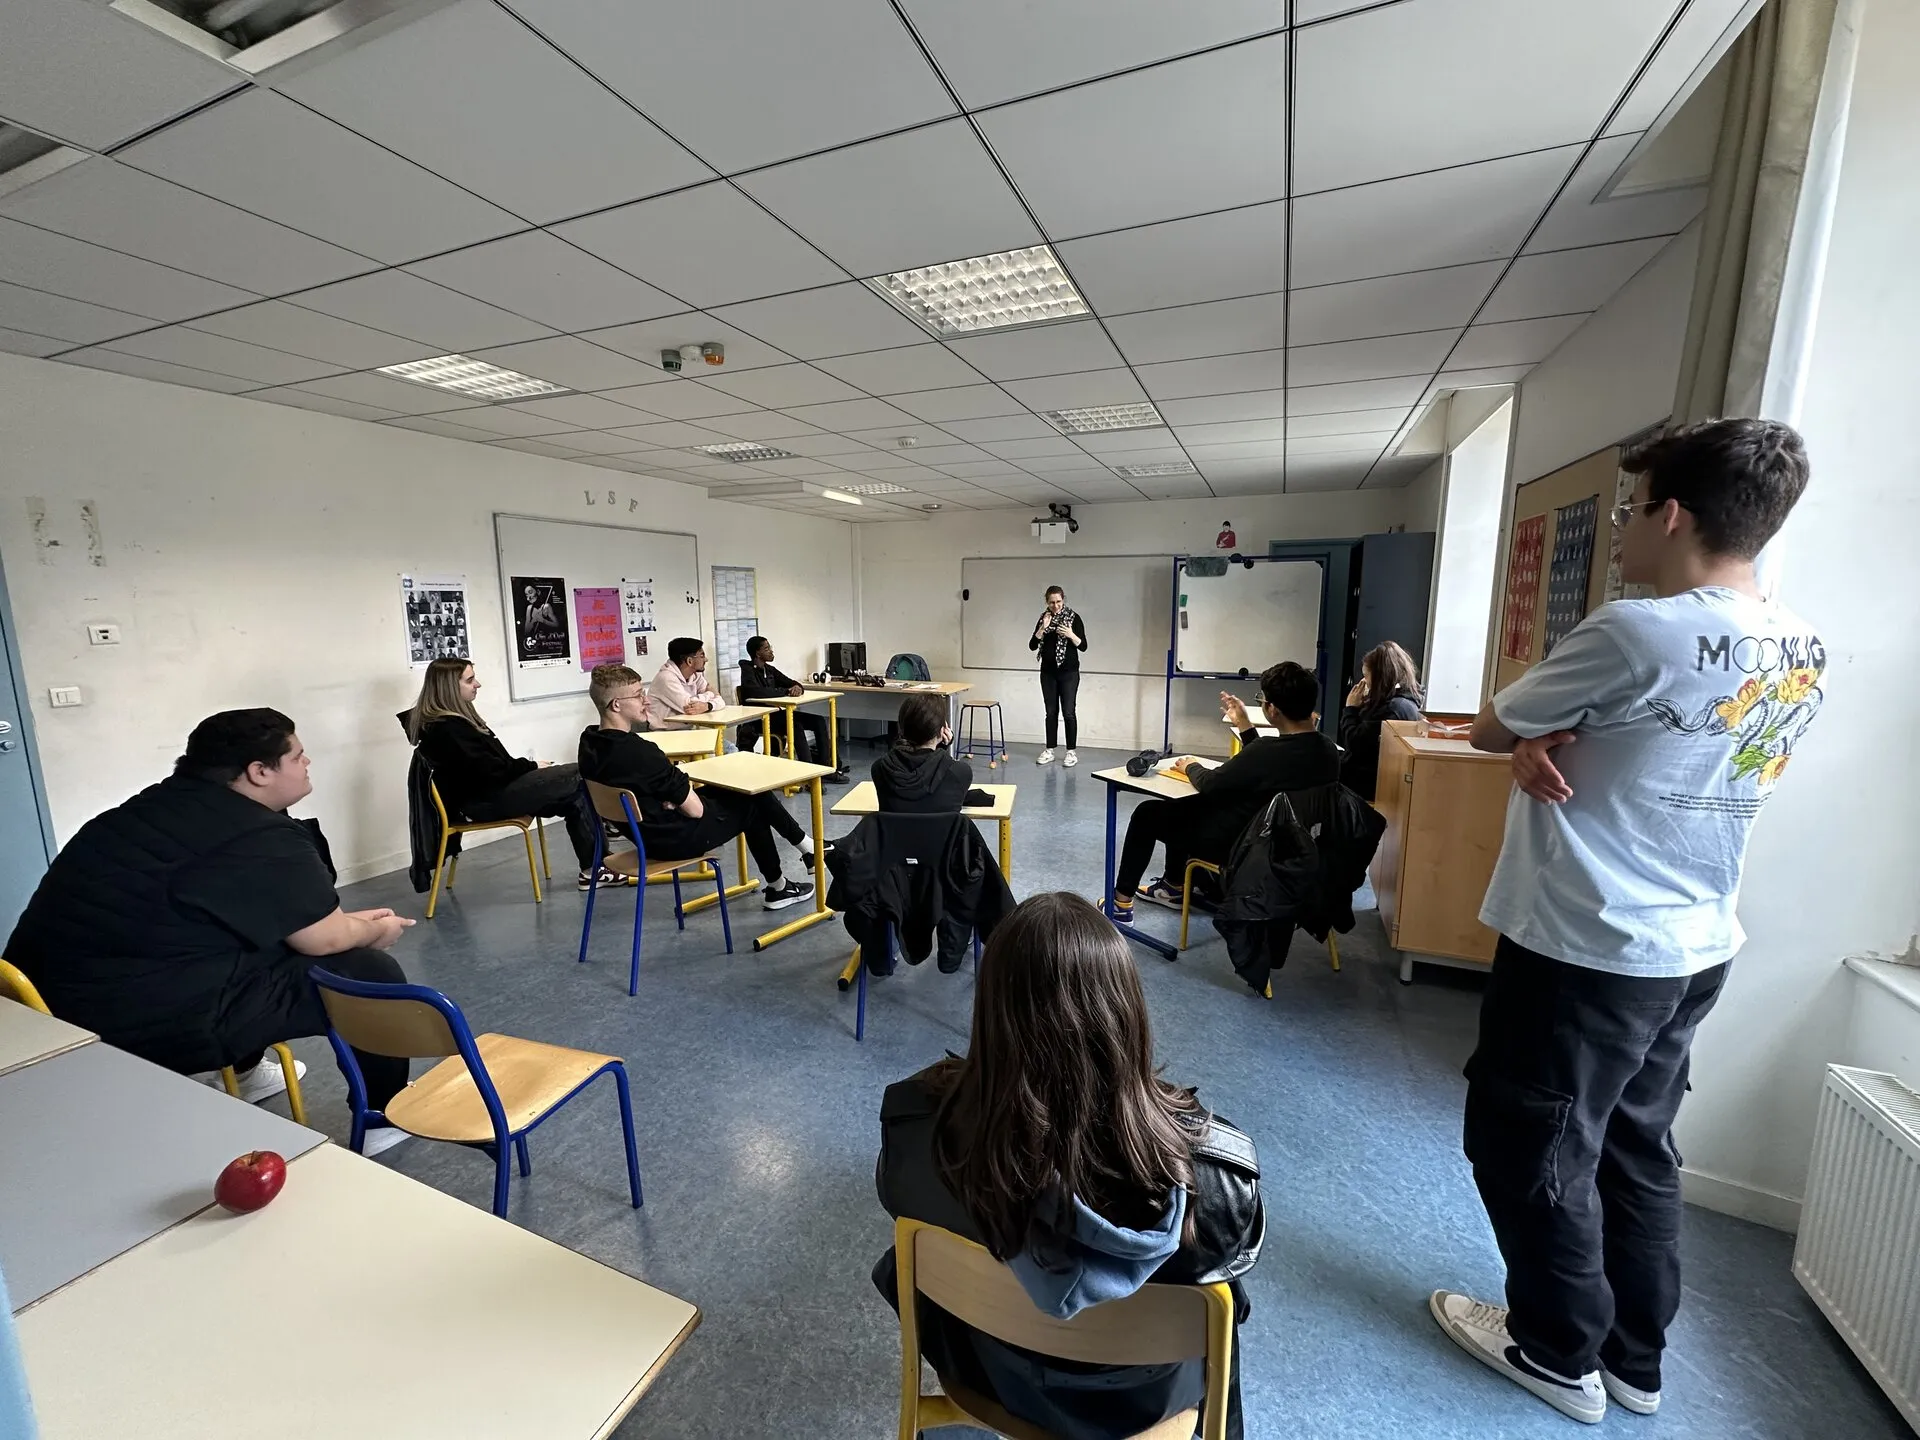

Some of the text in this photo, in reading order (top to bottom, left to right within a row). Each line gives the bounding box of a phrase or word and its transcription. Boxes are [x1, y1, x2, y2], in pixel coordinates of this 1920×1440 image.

[592, 599, 606, 611] JE
[582, 614, 617, 627] SIGNE
[585, 629, 617, 642] DONC
[582, 647, 596, 659] JE
[597, 644, 623, 657] SUIS
